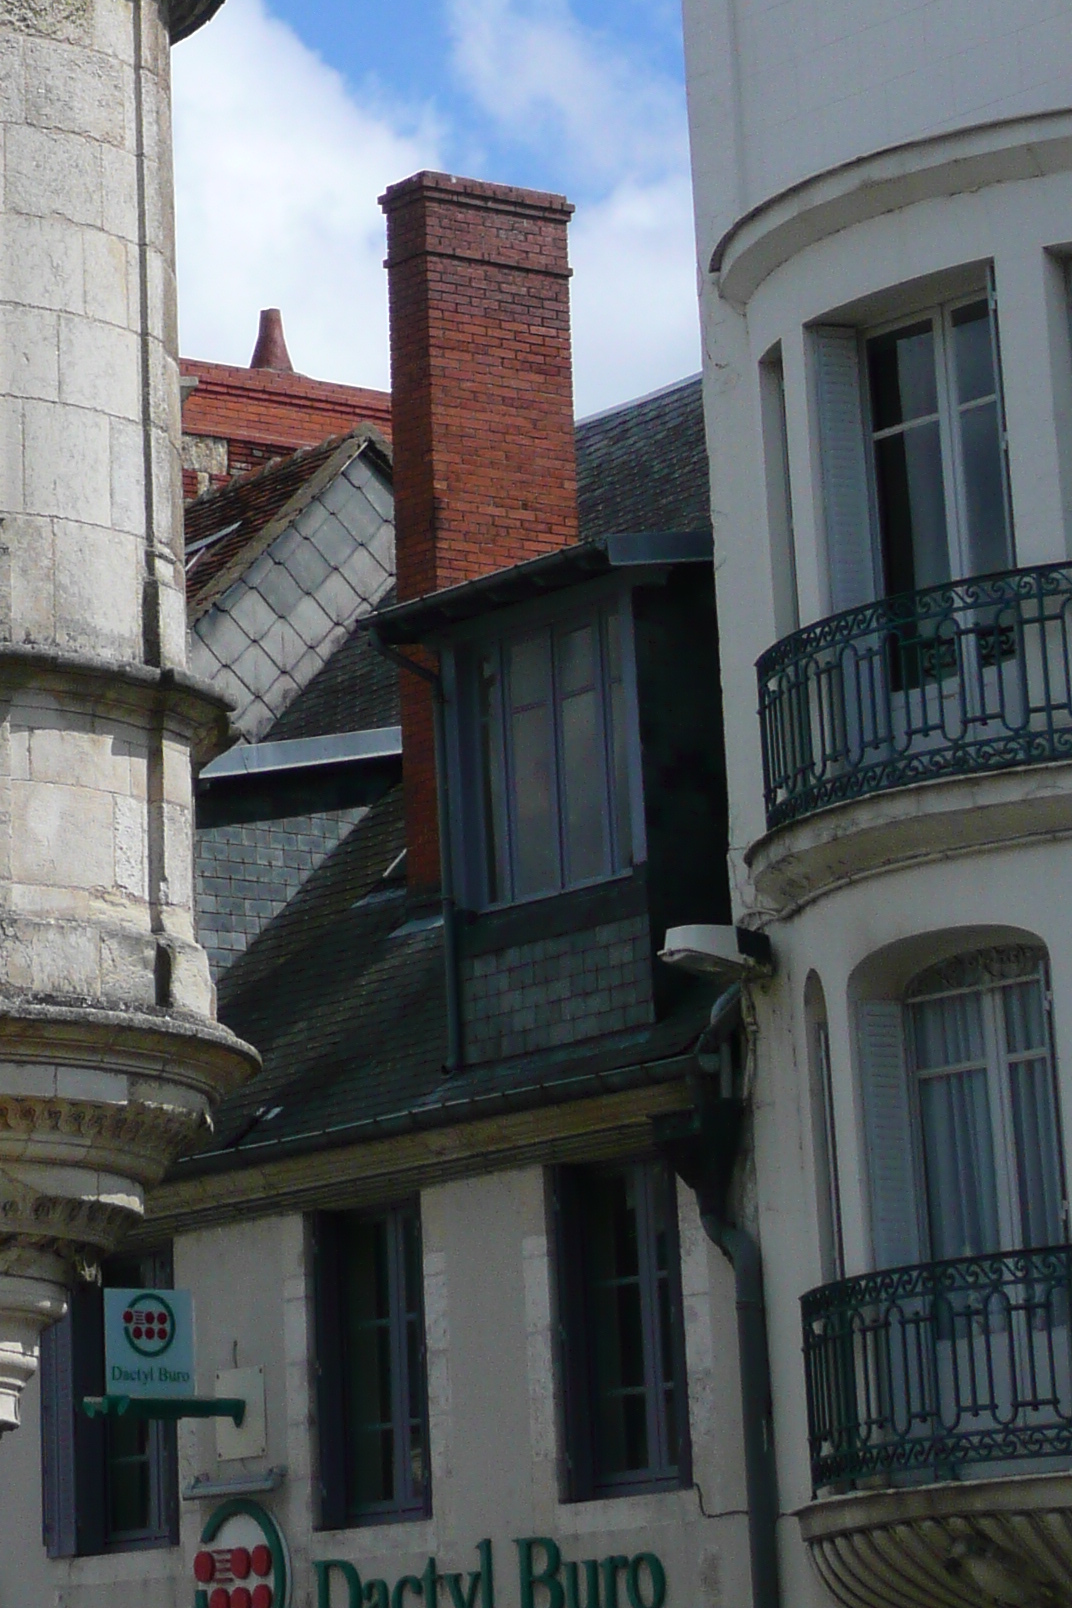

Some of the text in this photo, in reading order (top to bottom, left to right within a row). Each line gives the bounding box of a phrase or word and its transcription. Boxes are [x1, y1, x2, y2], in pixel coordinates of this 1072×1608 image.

[112, 1365, 190, 1385] Dactyl Buro
[512, 1536, 666, 1608] Buro
